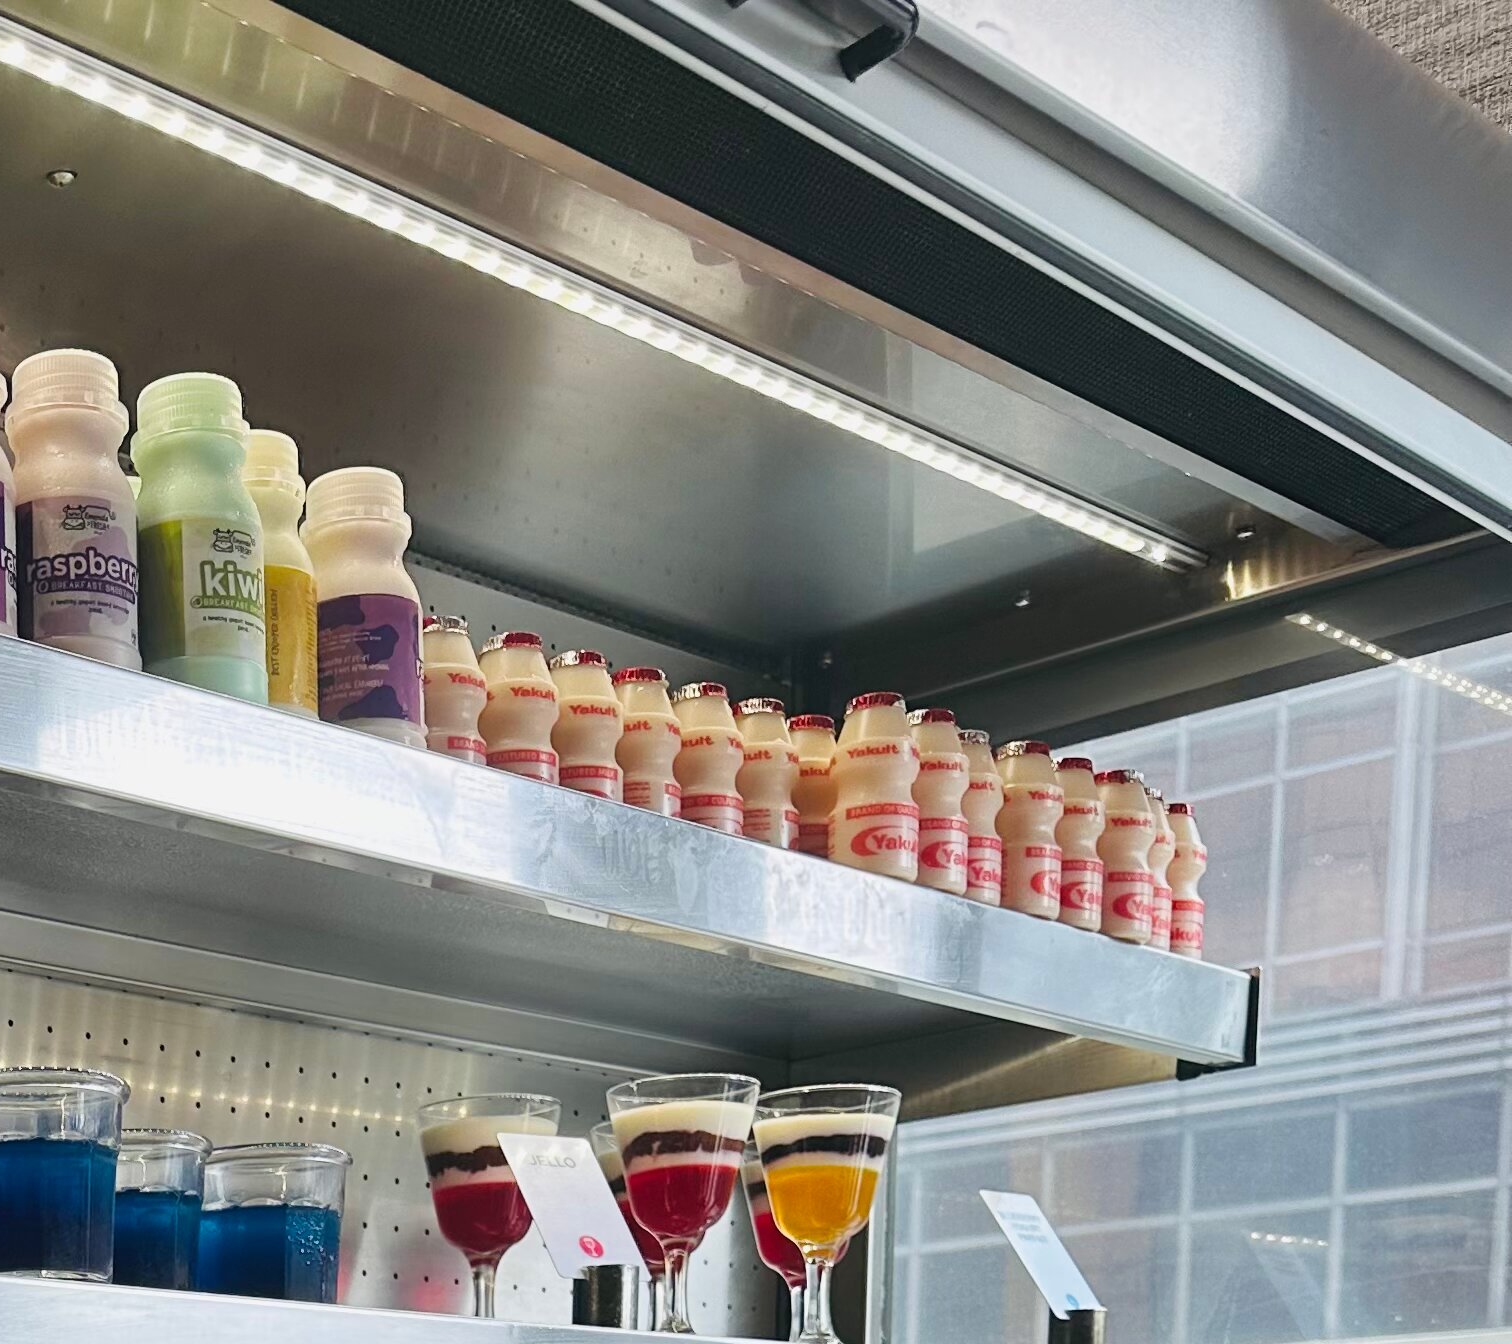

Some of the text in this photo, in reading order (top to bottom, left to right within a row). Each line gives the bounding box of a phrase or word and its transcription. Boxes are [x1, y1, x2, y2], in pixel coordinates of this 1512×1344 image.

[203, 563, 265, 606] kiwi
[569, 704, 618, 718] Yakult
[847, 744, 900, 759] Yakult
[527, 1154, 577, 1169] JELLO
